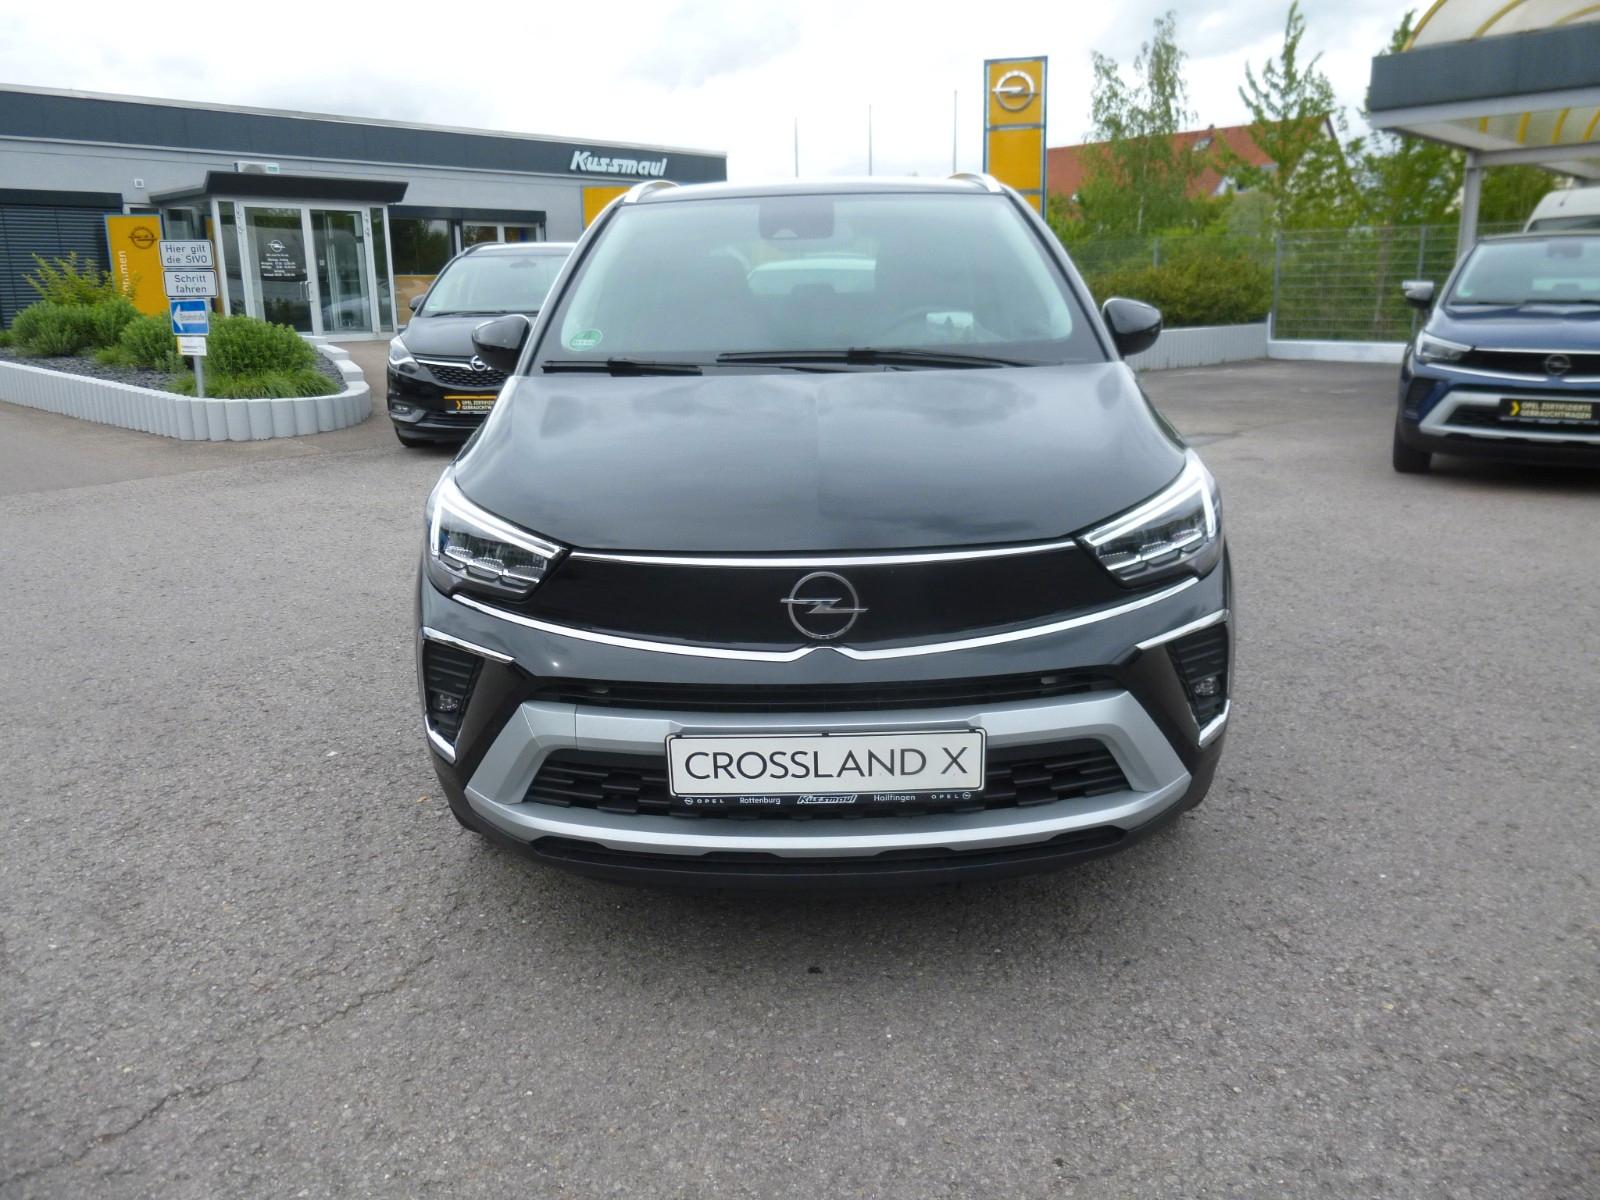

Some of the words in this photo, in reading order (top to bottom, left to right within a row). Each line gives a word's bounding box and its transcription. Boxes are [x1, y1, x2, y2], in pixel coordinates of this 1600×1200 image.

[569, 150, 668, 176] Kussmaul
[165, 244, 185, 253] Hier
[190, 244, 206, 255] gilt
[166, 255, 181, 264] die
[185, 255, 208, 264] StVO
[174, 274, 207, 283] Schritt
[175, 284, 207, 294] fahren
[684, 747, 927, 780] CROSSLAND
[940, 746, 969, 775] X
[739, 796, 781, 805] Rottenburg
[796, 793, 858, 805] Kussmaul
